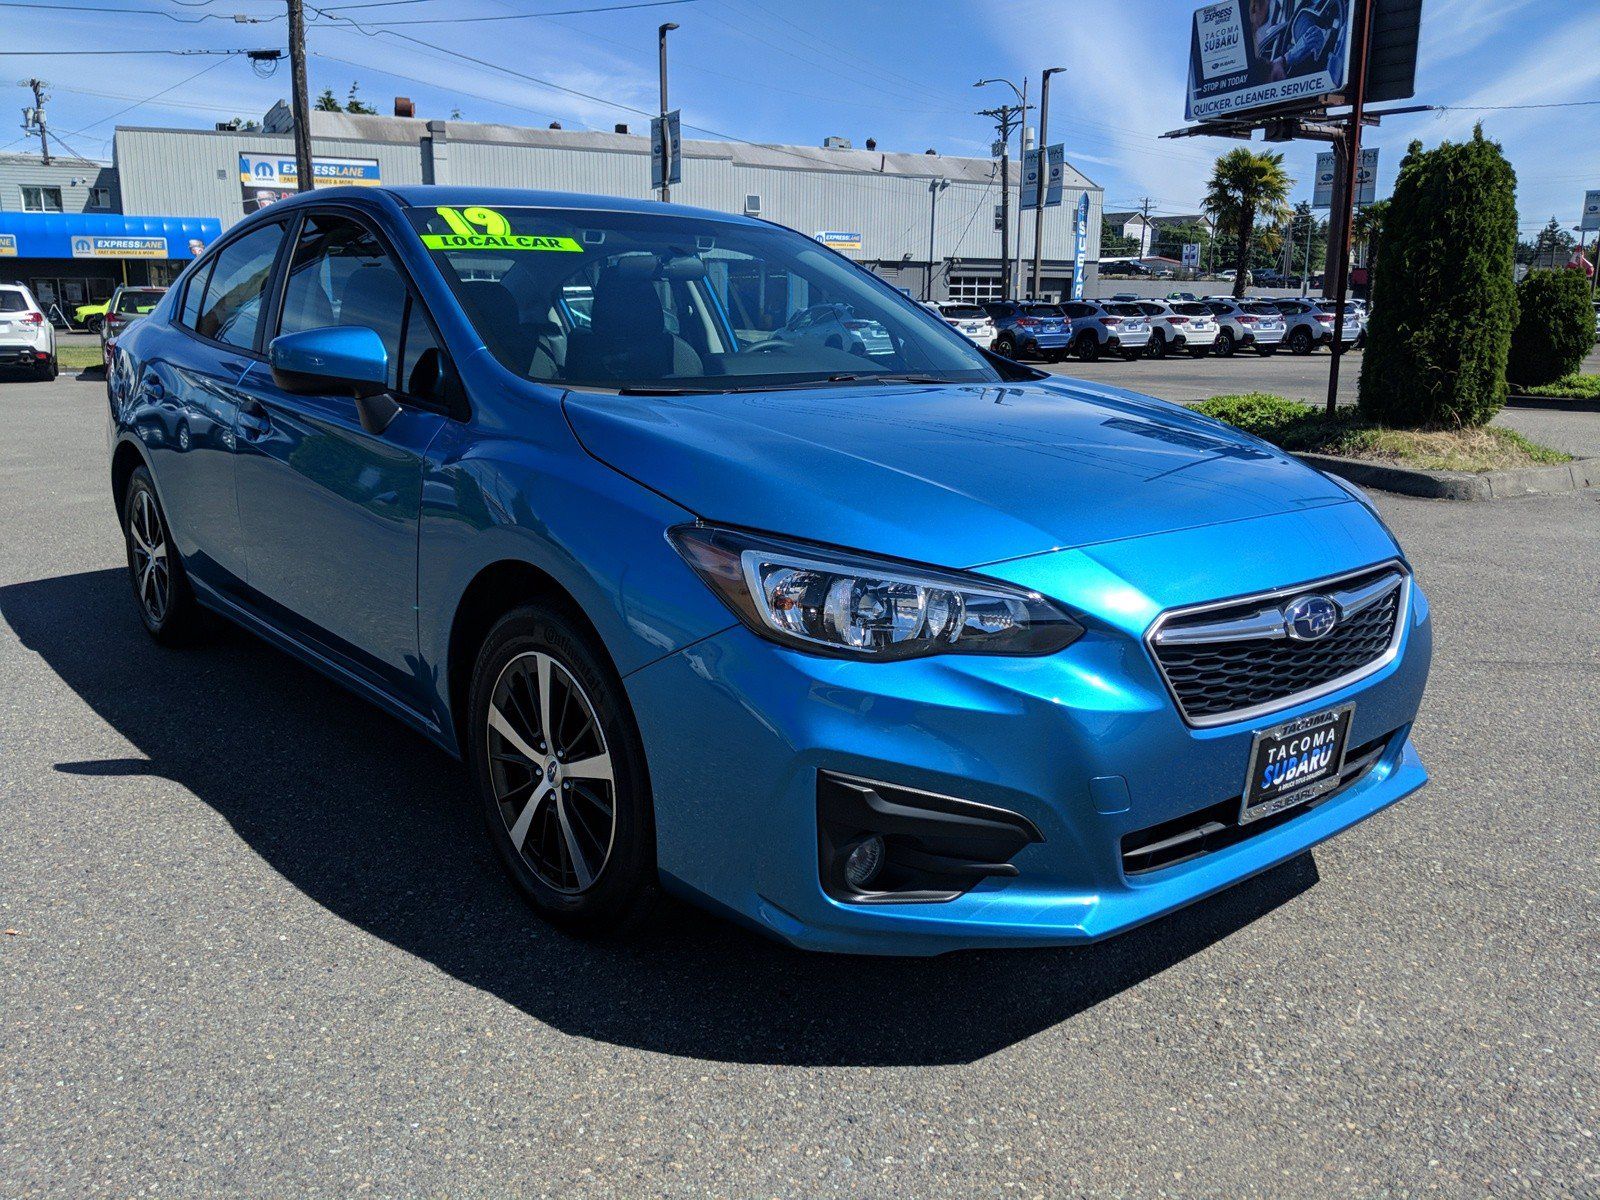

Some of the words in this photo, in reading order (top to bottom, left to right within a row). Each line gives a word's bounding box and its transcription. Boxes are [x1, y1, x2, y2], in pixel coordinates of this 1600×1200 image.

[1204, 33, 1239, 52] SUBARU
[1205, 25, 1239, 40] TACOMA
[1203, 82, 1219, 93] STOP
[1220, 79, 1227, 89] IN
[1227, 74, 1249, 87] TODAY
[1194, 98, 1232, 116] QUICKER.
[1235, 88, 1278, 106] CLEANER.
[1281, 77, 1325, 96] SERVICE.
[283, 163, 364, 177] EXESSLANE
[436, 207, 511, 236] 19
[97, 240, 162, 249] EXPRESSLANE
[440, 236, 514, 247] LOCAL
[515, 237, 563, 248] CAR
[1074, 221, 1086, 297] SUBAR
[1282, 711, 1333, 735] TACOMA
[1268, 728, 1335, 763] TACOMA
[1261, 743, 1334, 789] SUBARU
